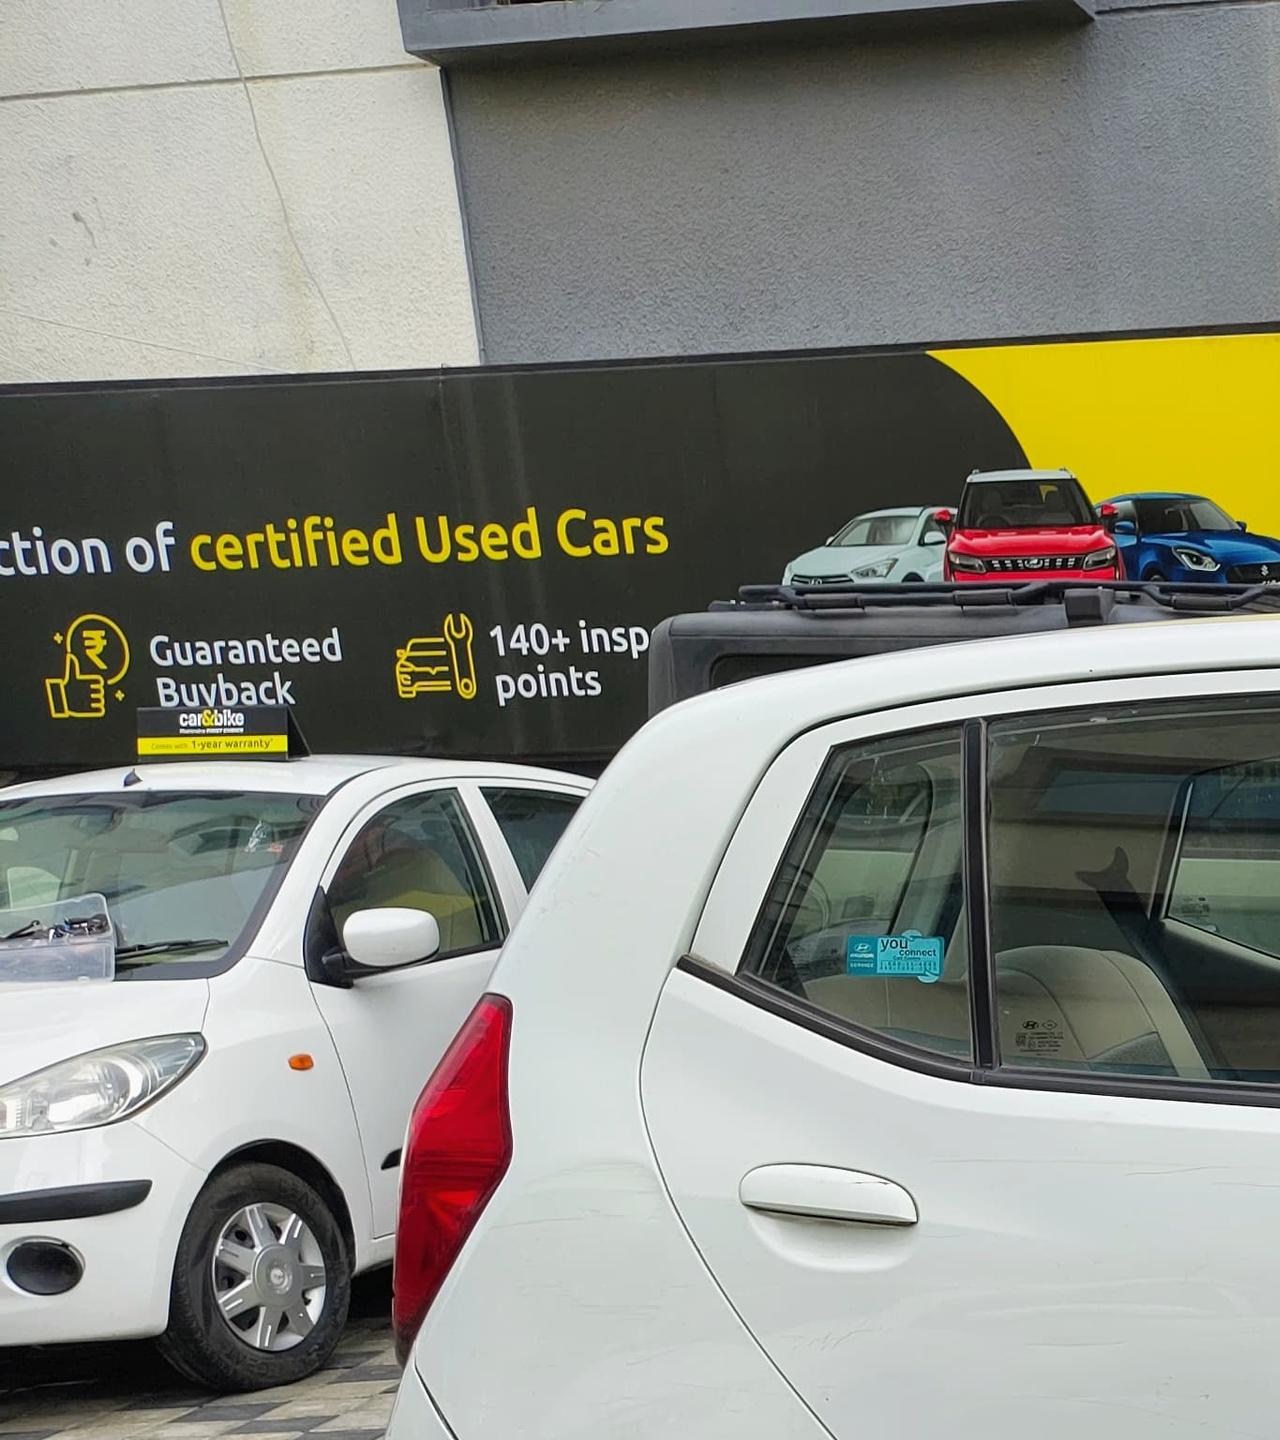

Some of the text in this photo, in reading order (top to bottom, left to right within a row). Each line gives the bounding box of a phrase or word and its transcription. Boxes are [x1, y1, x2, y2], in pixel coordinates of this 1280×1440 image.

[125, 520, 175, 573] of
[190, 511, 402, 571] certified
[415, 506, 542, 564] Used
[556, 508, 669, 558] Cars
[150, 627, 343, 667] Guaranteed
[489, 622, 571, 656] 140+
[156, 671, 296, 707] Buyback
[495, 664, 602, 706] points
[179, 708, 245, 727] car&bike
[880, 938, 909, 953] you
[899, 948, 937, 957] connect
